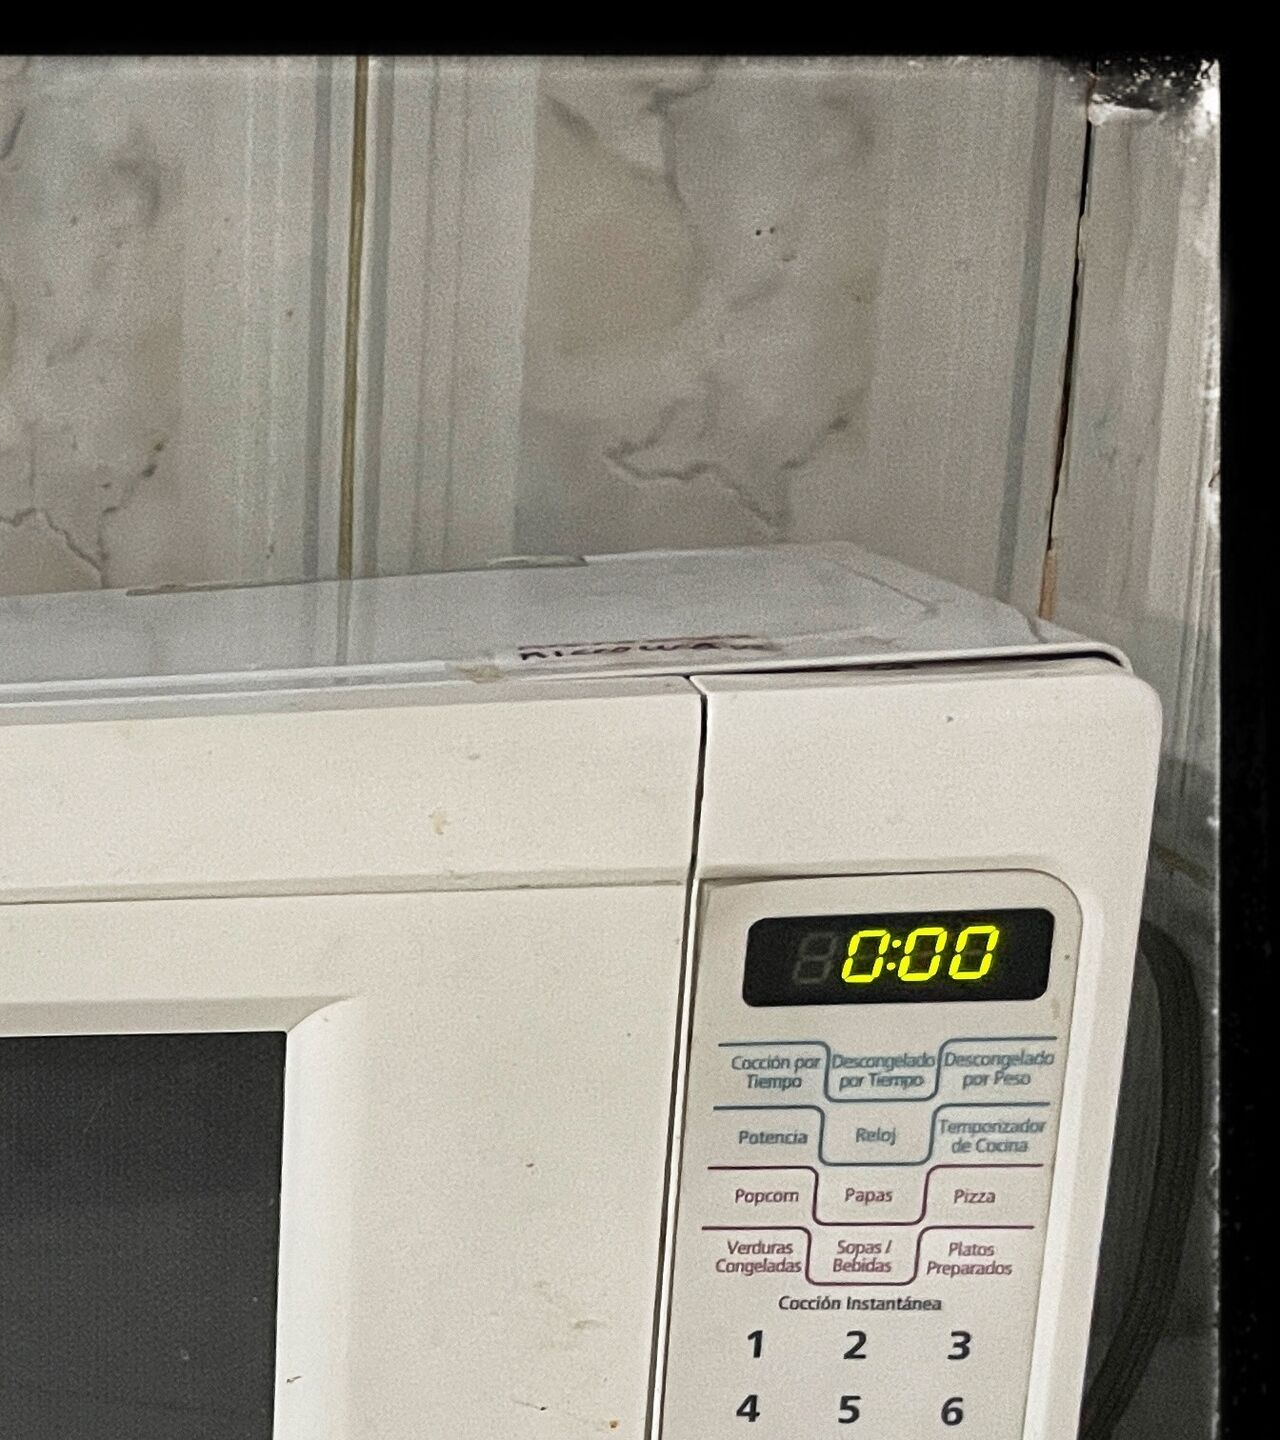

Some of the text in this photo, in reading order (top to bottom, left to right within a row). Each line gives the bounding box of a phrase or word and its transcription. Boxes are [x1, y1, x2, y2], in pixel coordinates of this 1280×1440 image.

[841, 925, 1000, 984] 0:00
[732, 1054, 821, 1073] Cocción por
[832, 1054, 936, 1071] Descongelado
[944, 1052, 1055, 1070] Descongelado
[747, 1073, 802, 1090] Tiempo
[840, 1072, 924, 1089] por Tiempo
[963, 1071, 1031, 1089] por Peso
[855, 1127, 897, 1145] Reloj
[940, 1118, 1047, 1137] Temporizador
[739, 1130, 808, 1145] Potencia
[952, 1138, 1029, 1153] de Cocina
[735, 1188, 799, 1206] Popcorn
[845, 1188, 893, 1206] Papas
[954, 1189, 996, 1204] Pizza
[727, 1240, 793, 1255] Verduras
[837, 1239, 882, 1260] Sopas
[948, 1242, 995, 1257] Platos
[715, 1258, 803, 1277] Congeladas
[833, 1258, 892, 1273] Bebidas
[926, 1261, 1012, 1278] Preparados
[779, 1295, 943, 1311] Cocción Instantánea
[746, 1330, 764, 1359] 1
[843, 1330, 868, 1360] 2
[947, 1330, 973, 1361] 3
[736, 1394, 761, 1423] 4
[838, 1396, 861, 1424] 5
[940, 1396, 965, 1427] 6
